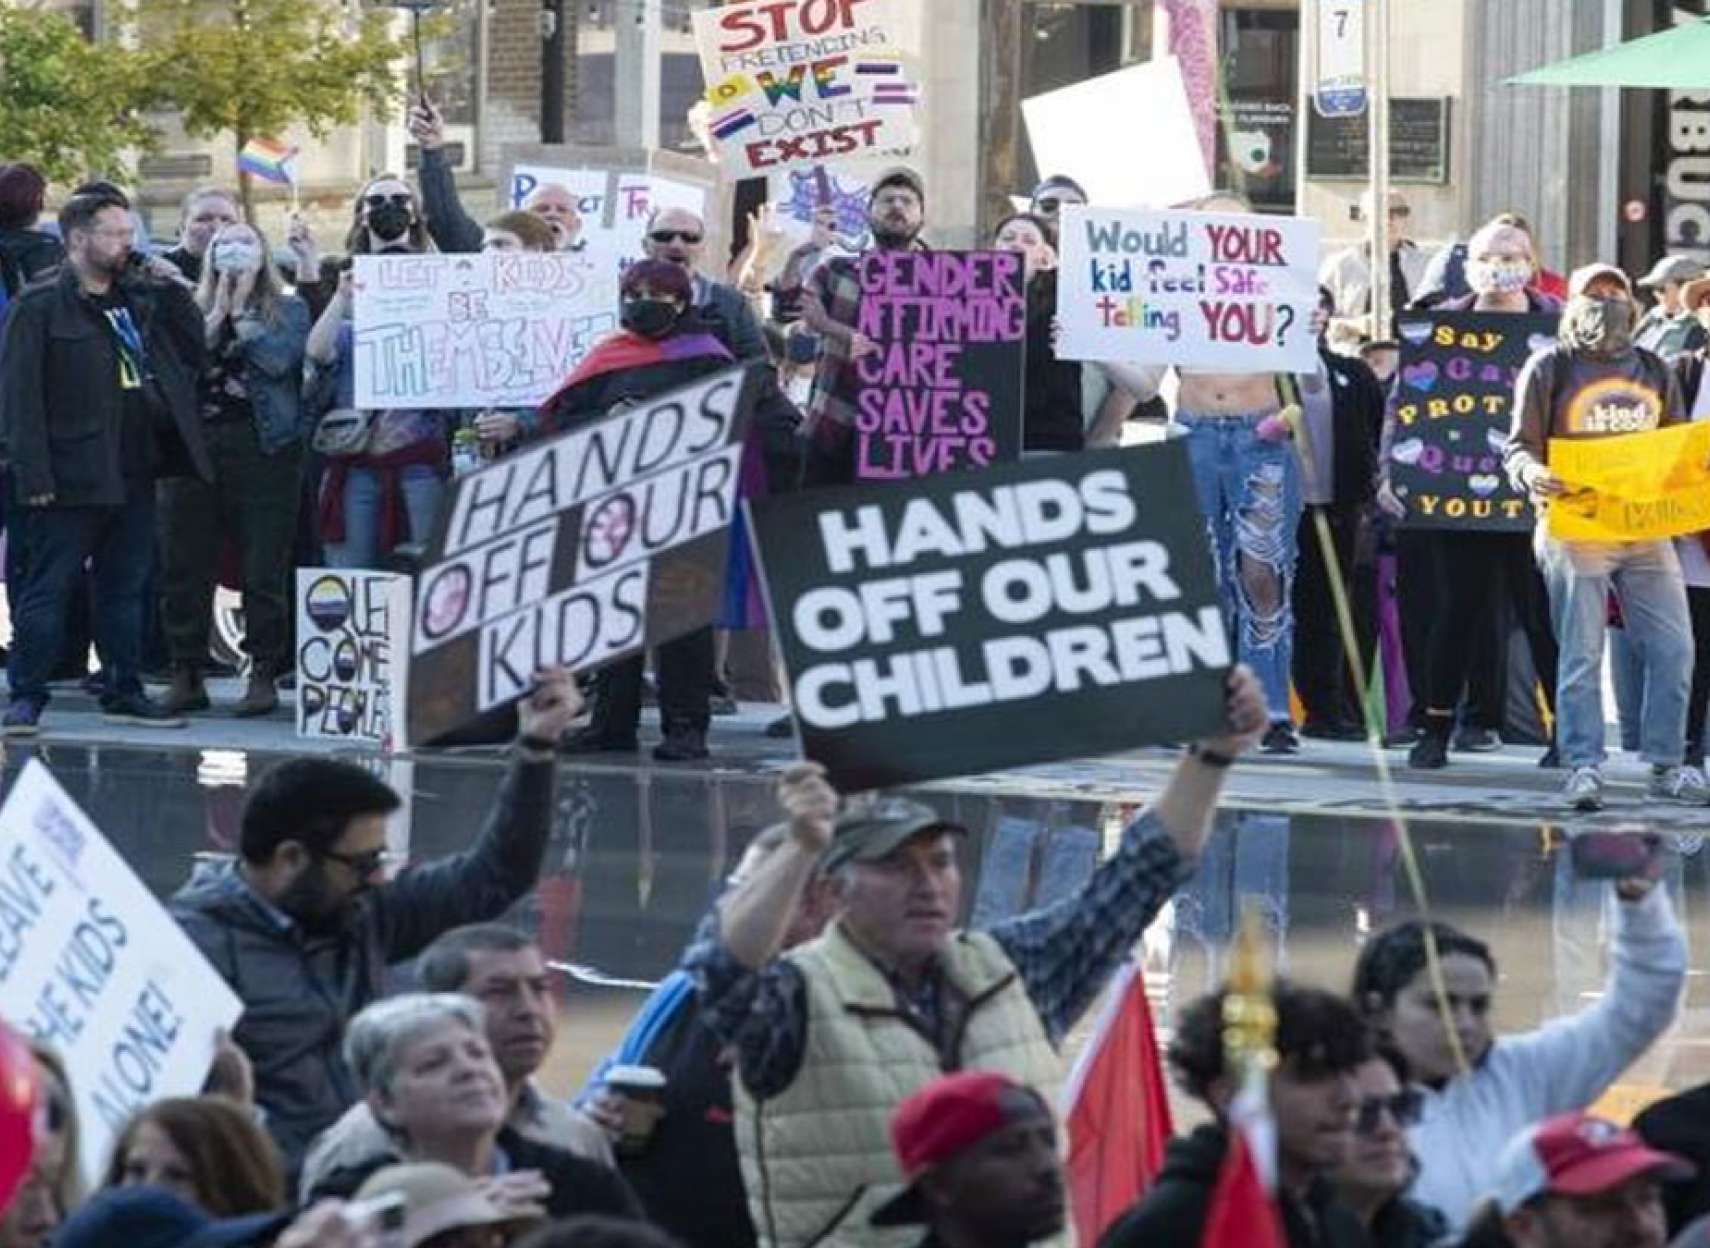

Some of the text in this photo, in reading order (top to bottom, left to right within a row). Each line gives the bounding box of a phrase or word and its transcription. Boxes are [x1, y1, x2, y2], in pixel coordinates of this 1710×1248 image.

[720, 0, 874, 52] STOP
[1333, 10, 1348, 38] 7
[756, 55, 851, 107] WE
[745, 119, 883, 168] EXIST
[1085, 219, 1289, 266] Would YOUR
[379, 253, 587, 299] LET KIDS
[859, 252, 1019, 297] GENDER
[1091, 258, 1132, 294] kid
[1147, 258, 1206, 294] feel
[447, 290, 489, 321] BE
[860, 292, 1026, 342] AFFIRMING
[1096, 296, 1296, 347] telling YOU?
[1434, 324, 1504, 352] Say
[857, 341, 962, 388] CARE
[855, 387, 991, 436] SAVES
[1398, 394, 1506, 426] PROT
[458, 378, 735, 547] HANDS
[859, 433, 996, 479] LIVES
[818, 470, 1137, 573] HANDS
[1420, 494, 1526, 519] YOUT
[421, 456, 732, 639] OFF OUR
[793, 540, 1181, 652] OFF OUR
[488, 570, 643, 702] KIDS
[793, 606, 1232, 729] CHILDREN
[55, 897, 128, 1011] KIDS
